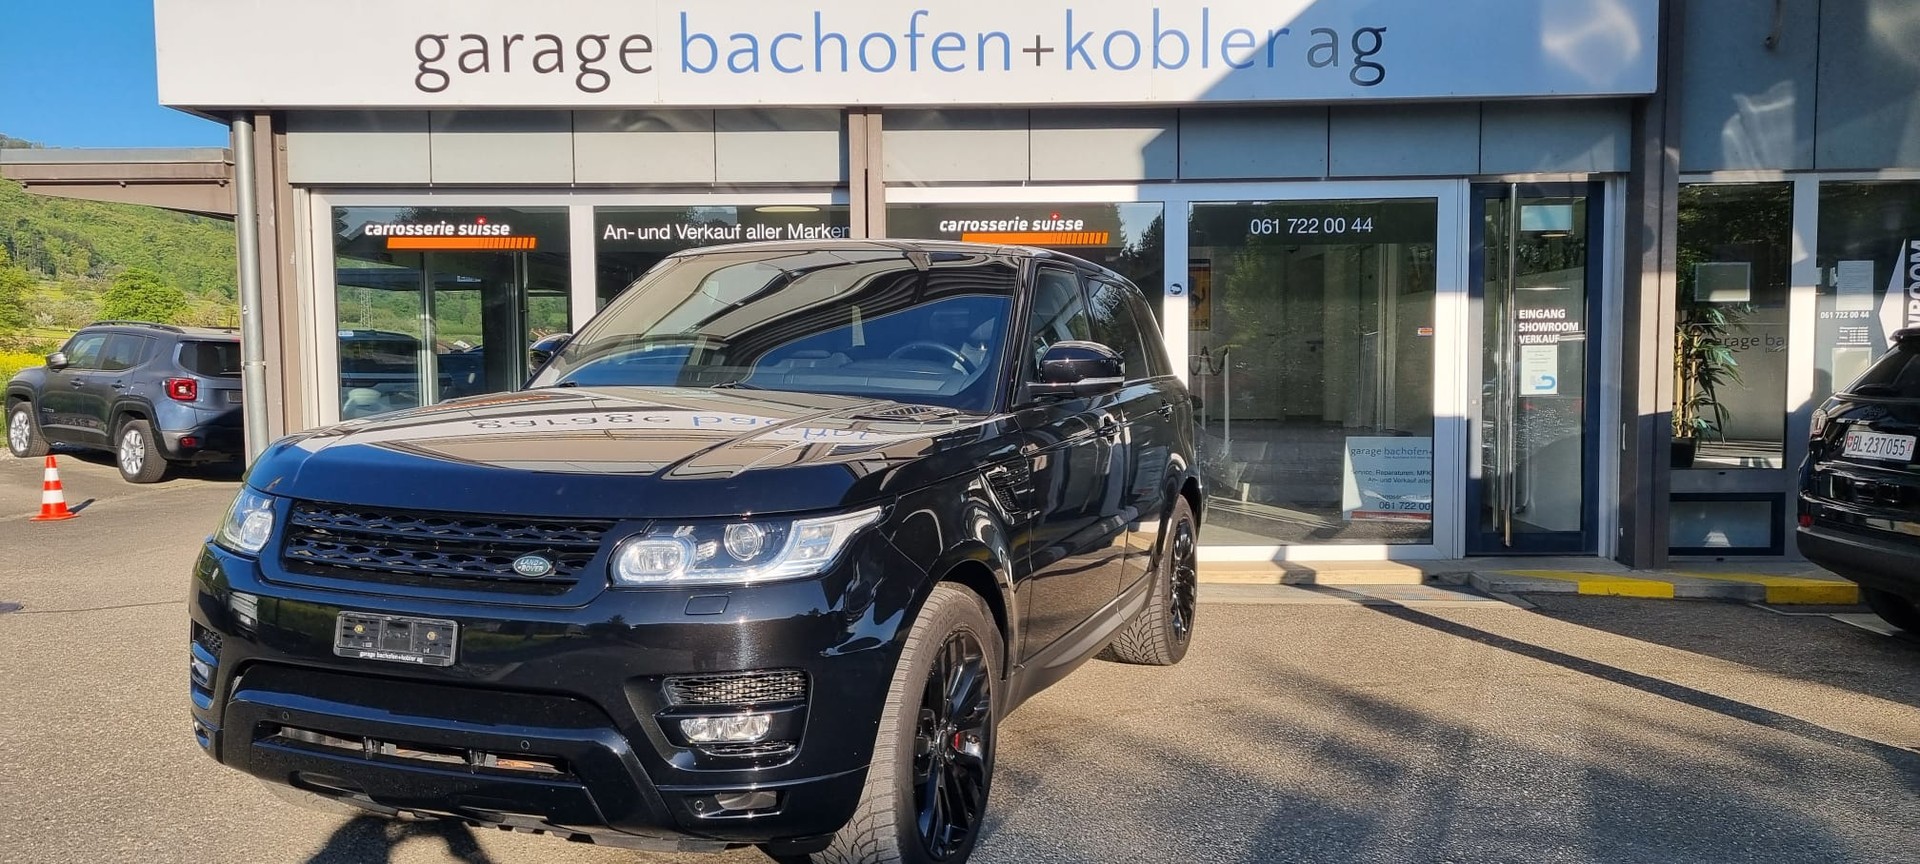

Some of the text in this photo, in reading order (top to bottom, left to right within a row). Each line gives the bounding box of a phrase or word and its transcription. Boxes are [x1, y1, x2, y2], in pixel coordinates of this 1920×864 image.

[414, 8, 1387, 93] garage bachofen+kobler ag
[365, 216, 510, 236] carrosserie suisse
[939, 212, 1084, 232] carrosserie suisse
[1250, 217, 1373, 234] 061 722 00 44
[676, 224, 742, 240] Verkauf
[746, 224, 783, 239] aller
[1519, 309, 1565, 318] EINGANG
[1519, 322, 1578, 331] SHOWROOM
[1519, 335, 1560, 344] VERKAUF
[1700, 336, 1760, 350] arage
[1351, 448, 1382, 458] garage
[1379, 501, 1396, 510] 061
[1399, 501, 1417, 510] 722
